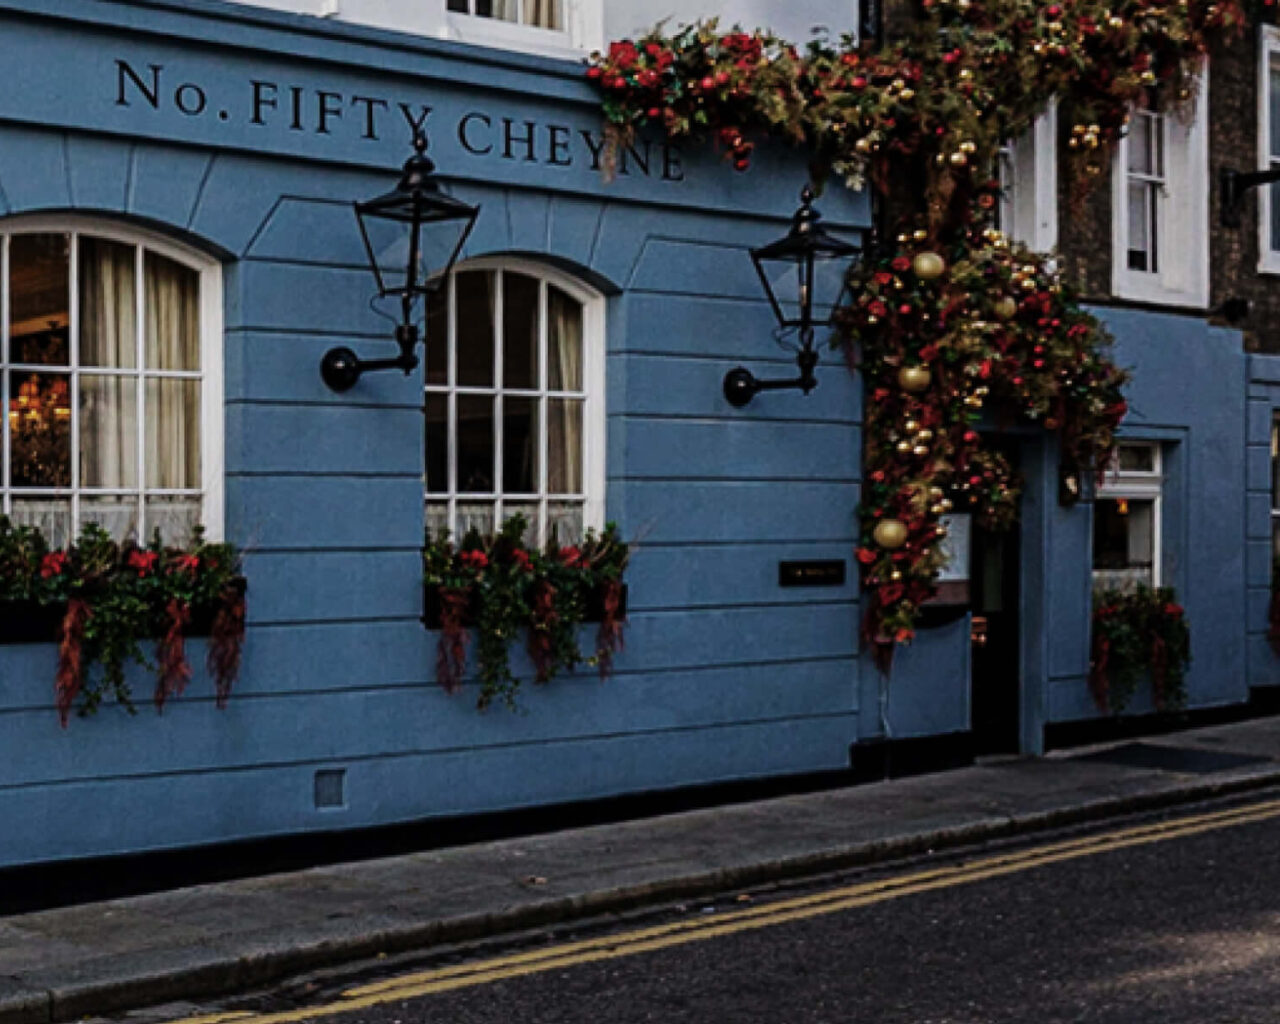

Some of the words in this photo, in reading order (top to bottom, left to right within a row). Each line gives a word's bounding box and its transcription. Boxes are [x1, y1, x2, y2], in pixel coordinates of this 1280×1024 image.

[113, 59, 229, 122] No.
[249, 79, 433, 147] FIFTY
[457, 111, 685, 182] CHEYNE
